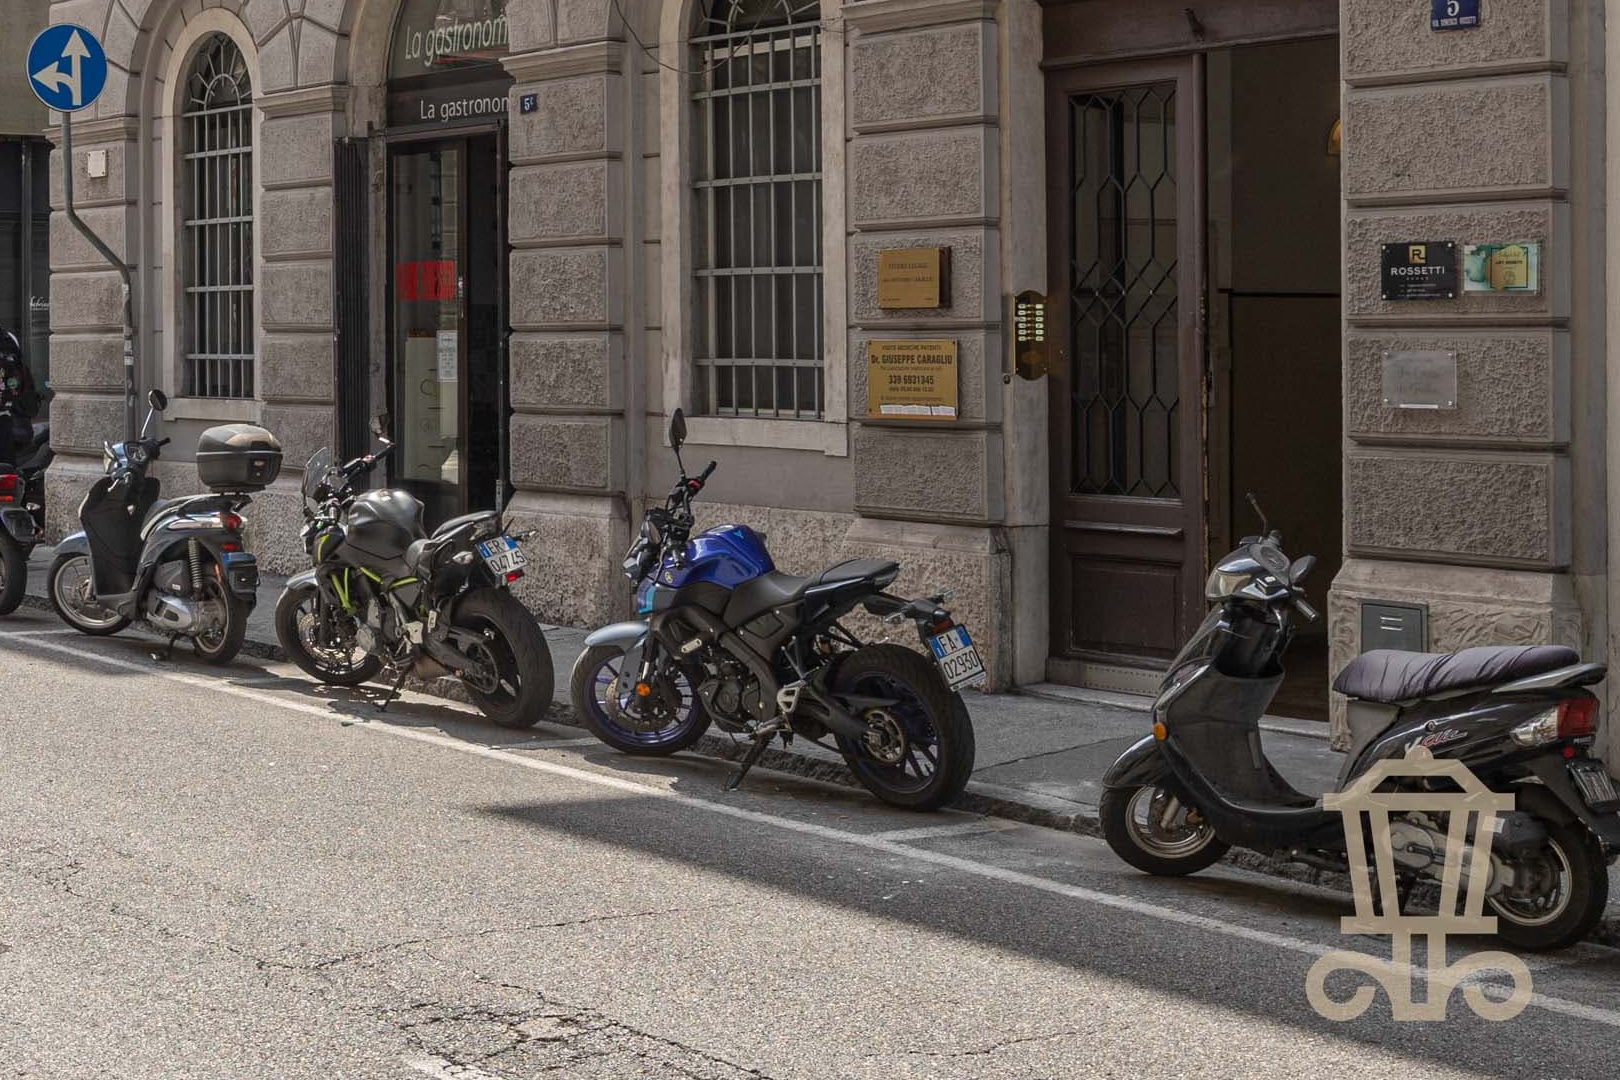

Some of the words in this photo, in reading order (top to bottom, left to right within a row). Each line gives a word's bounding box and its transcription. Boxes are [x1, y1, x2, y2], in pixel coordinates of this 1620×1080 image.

[405, 26, 421, 60] La
[420, 100, 435, 119] La
[1390, 266, 1445, 276] ROSSETTI
[881, 354, 916, 364] GIUSEPPE
[486, 540, 504, 553] ER
[939, 634, 957, 655] FA
[943, 650, 979, 679] 02930
